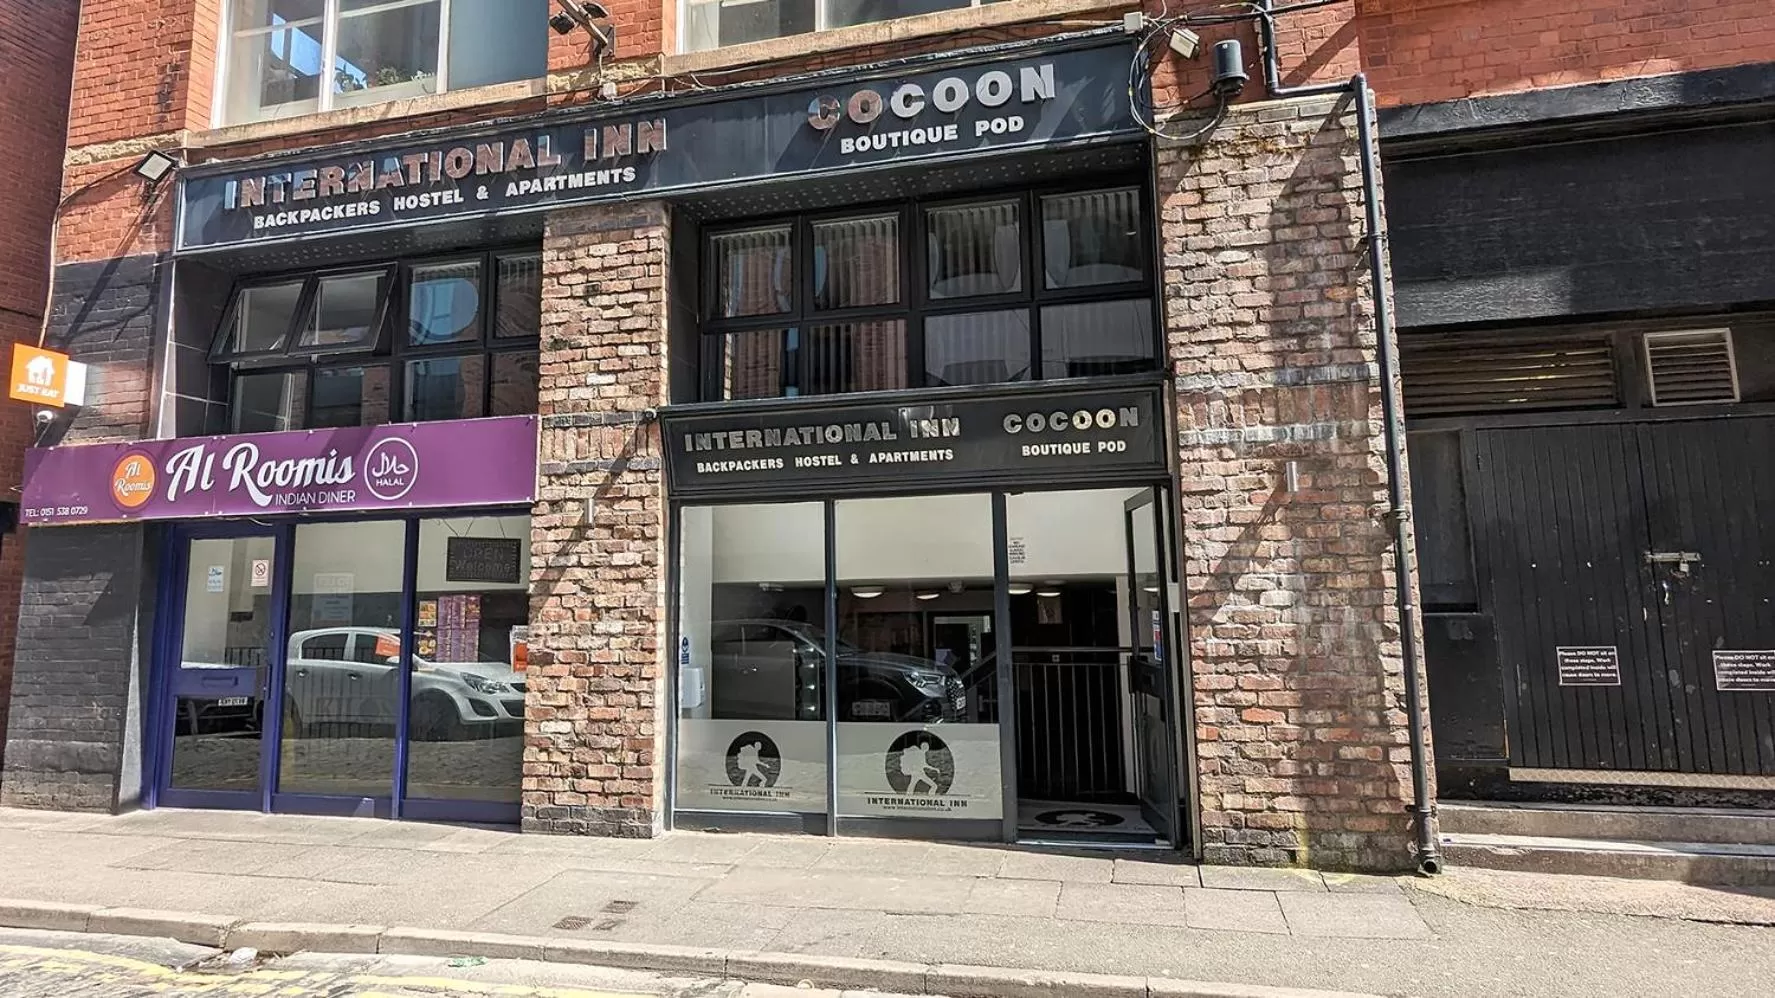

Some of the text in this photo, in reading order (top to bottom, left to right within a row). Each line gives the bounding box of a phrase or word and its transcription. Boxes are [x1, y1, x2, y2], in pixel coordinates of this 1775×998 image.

[808, 64, 1055, 130] COCOON
[841, 116, 1024, 154] BOUTIQUE POD
[224, 117, 668, 210] INTERNATIONAL INN
[253, 167, 636, 229] BACKPACKERS HOSTEL & APARTMENTS
[1003, 407, 1139, 433] COCOON
[684, 417, 961, 452] INTERNATIONAL INN
[1021, 440, 1126, 457] BOUTIQUE POD
[125, 462, 141, 478] Al
[696, 448, 954, 473] BACKPACKERS HOSTEL & APARTMENTS
[166, 442, 356, 507] Al Roomis
[376, 478, 404, 487] HALAL
[114, 478, 152, 497] Roomis
[275, 490, 356, 506] INDIAN DINER
[25, 506, 88, 517] TEL: 0151 538 0729
[710, 788, 772, 797] INTERNATIONAL
[868, 797, 946, 807] INTERNATIONAL
